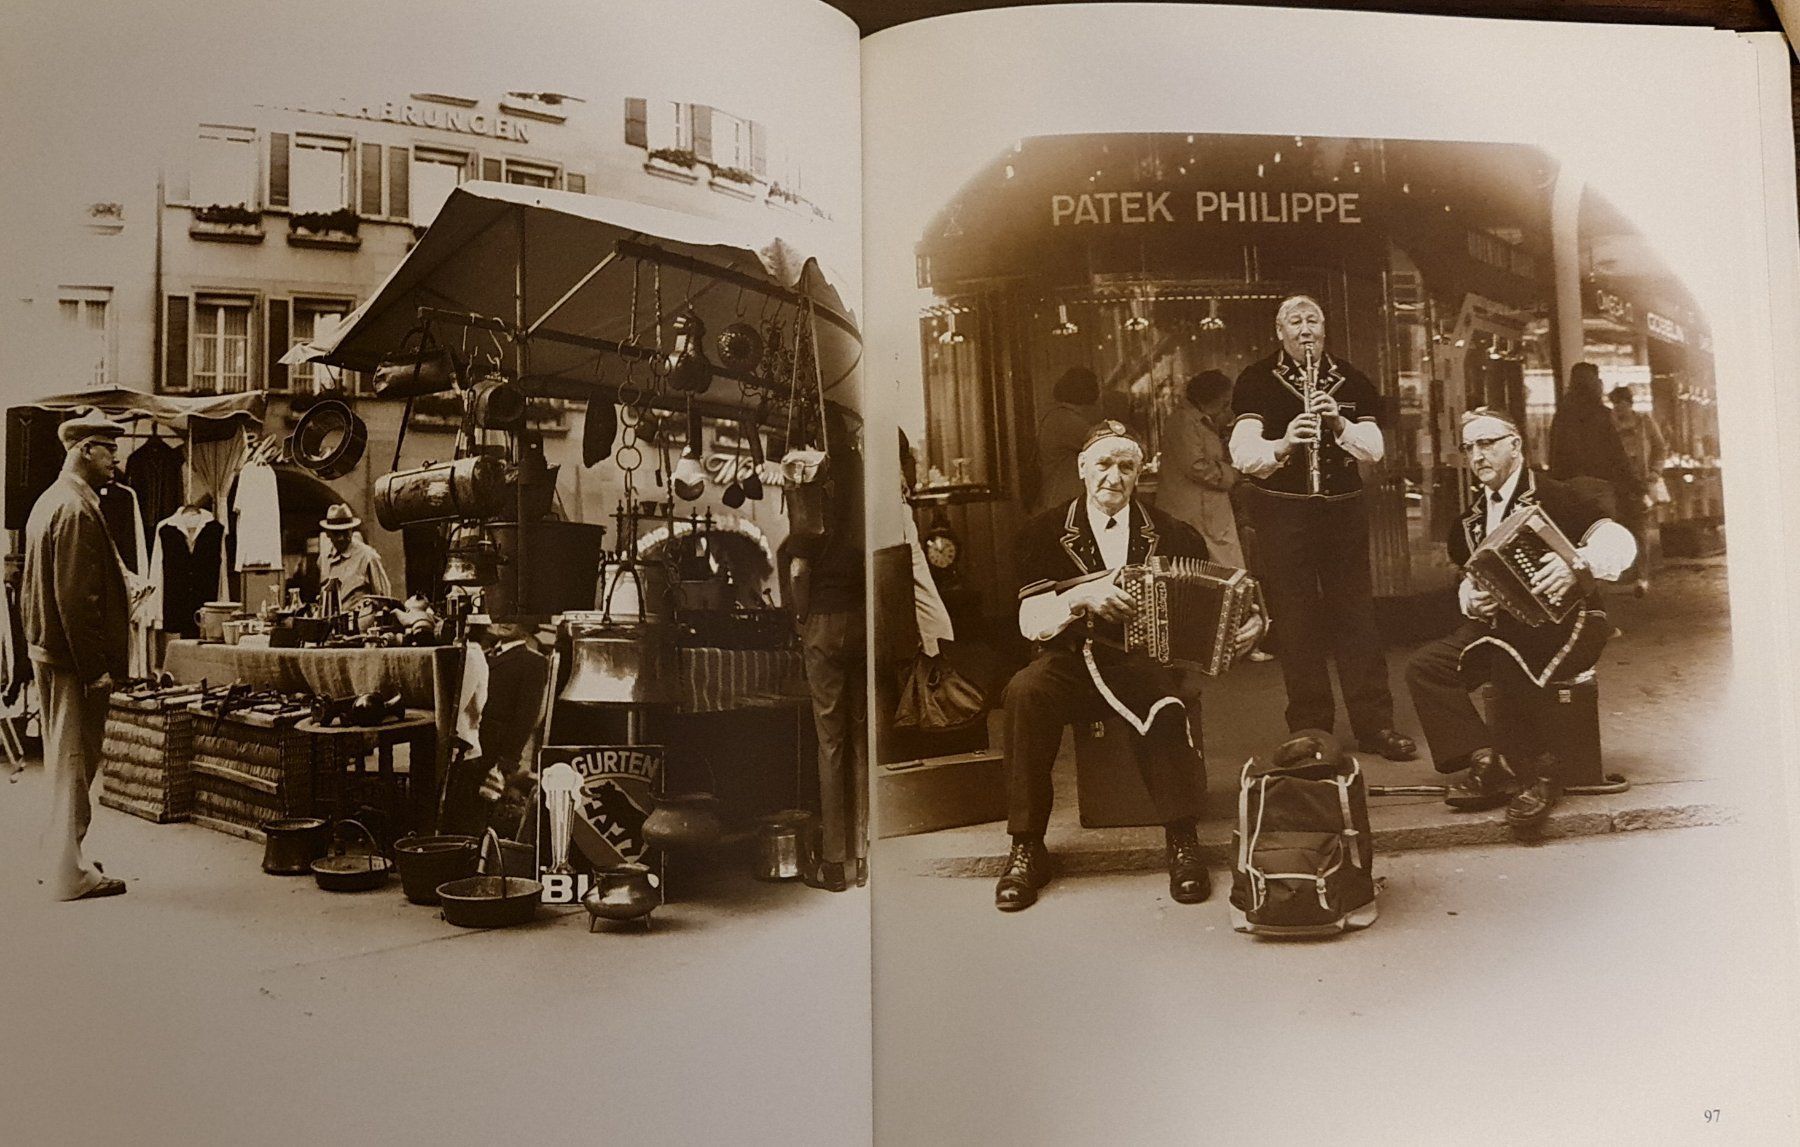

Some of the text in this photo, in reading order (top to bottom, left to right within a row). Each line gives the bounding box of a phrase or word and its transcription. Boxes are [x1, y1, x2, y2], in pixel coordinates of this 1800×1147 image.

[1051, 190, 1361, 226] PATEK PHILIPPE
[571, 750, 660, 780] GURTEN
[1704, 1109, 1721, 1123] 97
